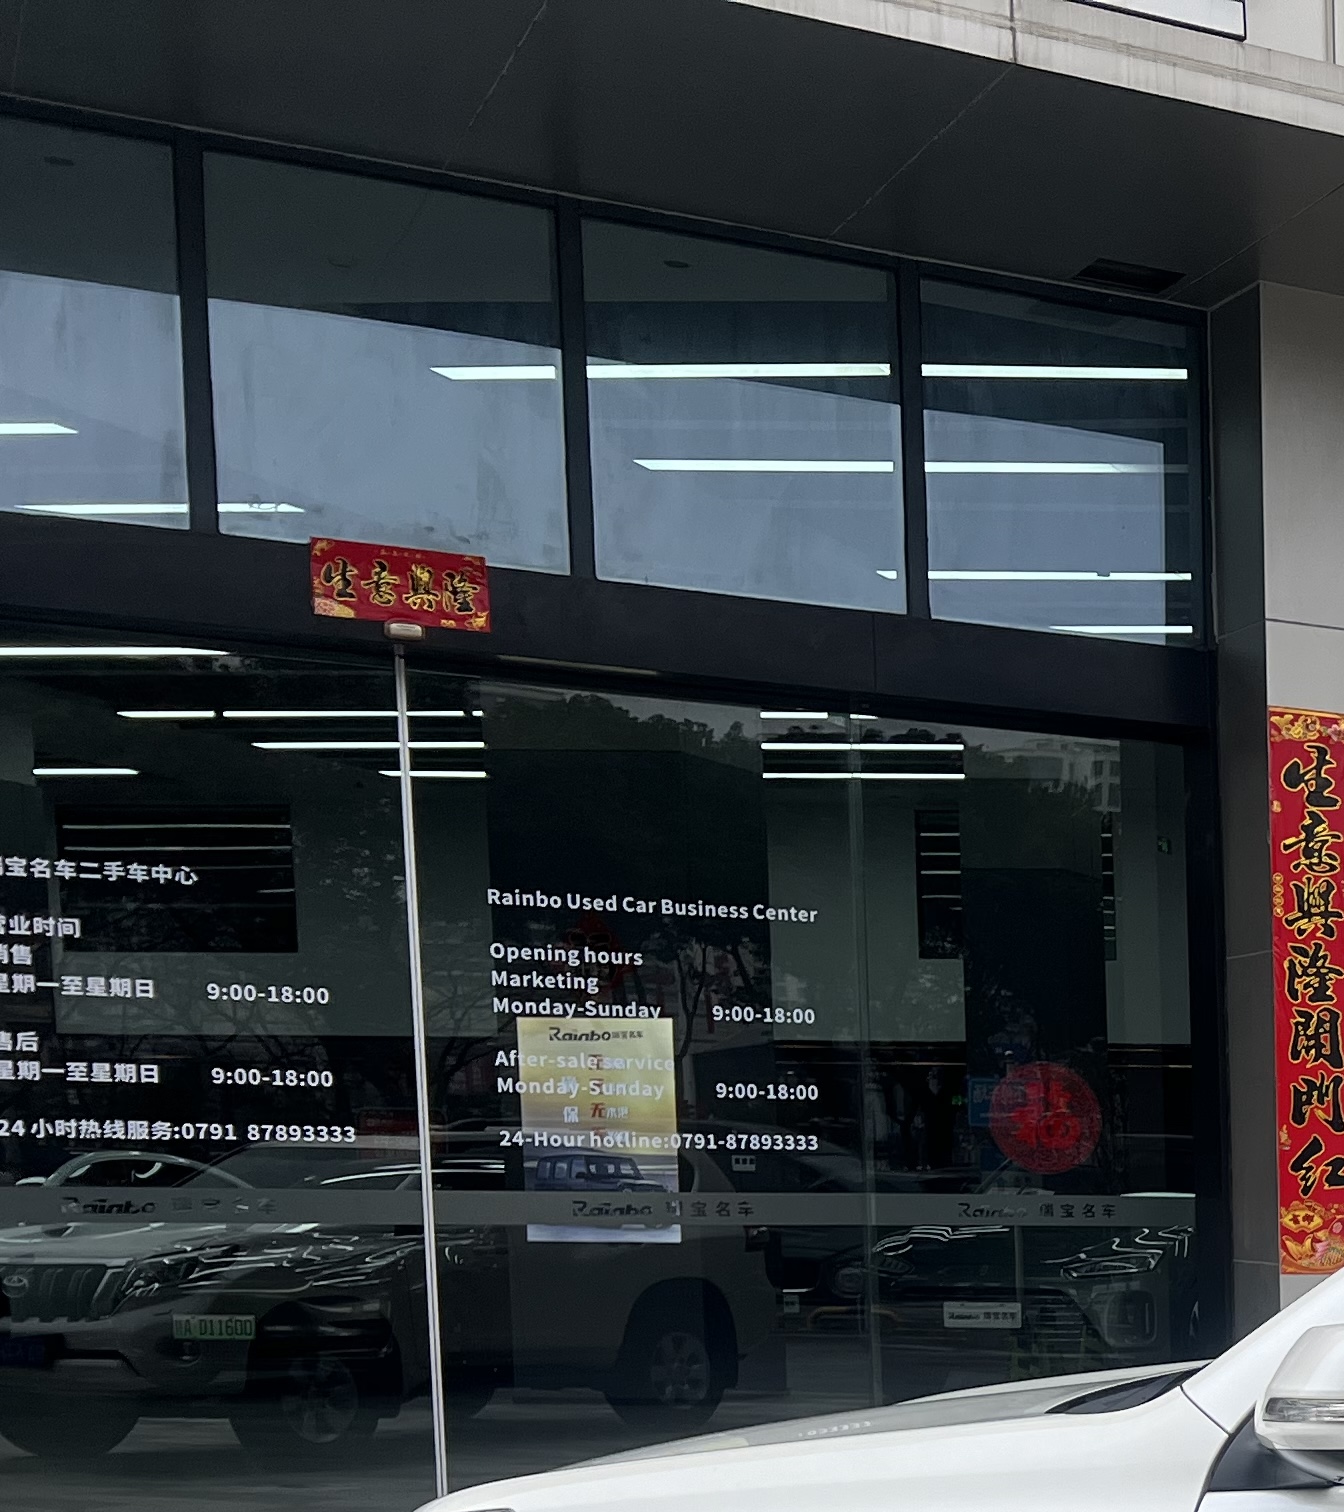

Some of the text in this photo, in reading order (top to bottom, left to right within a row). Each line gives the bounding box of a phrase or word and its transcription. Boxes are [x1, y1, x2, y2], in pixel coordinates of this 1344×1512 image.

[0, 856, 199, 886] 宝名车二手车中心
[487, 888, 818, 923] Rainbo Used Car Business Center
[489, 943, 644, 966] Opening hours
[491, 970, 599, 994] Marketing
[206, 983, 330, 1005] 9:00-18:00
[492, 997, 815, 1024] Monday-Sunday 9:00-18:00
[548, 1026, 611, 1041] Rainbo
[494, 1050, 597, 1070] After-sale
[602, 1053, 675, 1072] service
[0, 1059, 334, 1088] 星期一至星期日 9:00-18:00
[497, 1077, 664, 1101] Monday-Sunday
[715, 1083, 819, 1101] 9:00-18:00
[0, 1121, 25, 1138] 24
[247, 1123, 356, 1143] 87893333
[499, 1129, 585, 1148] 24-Hour
[589, 1131, 819, 1150] hotline:0791-87893333
